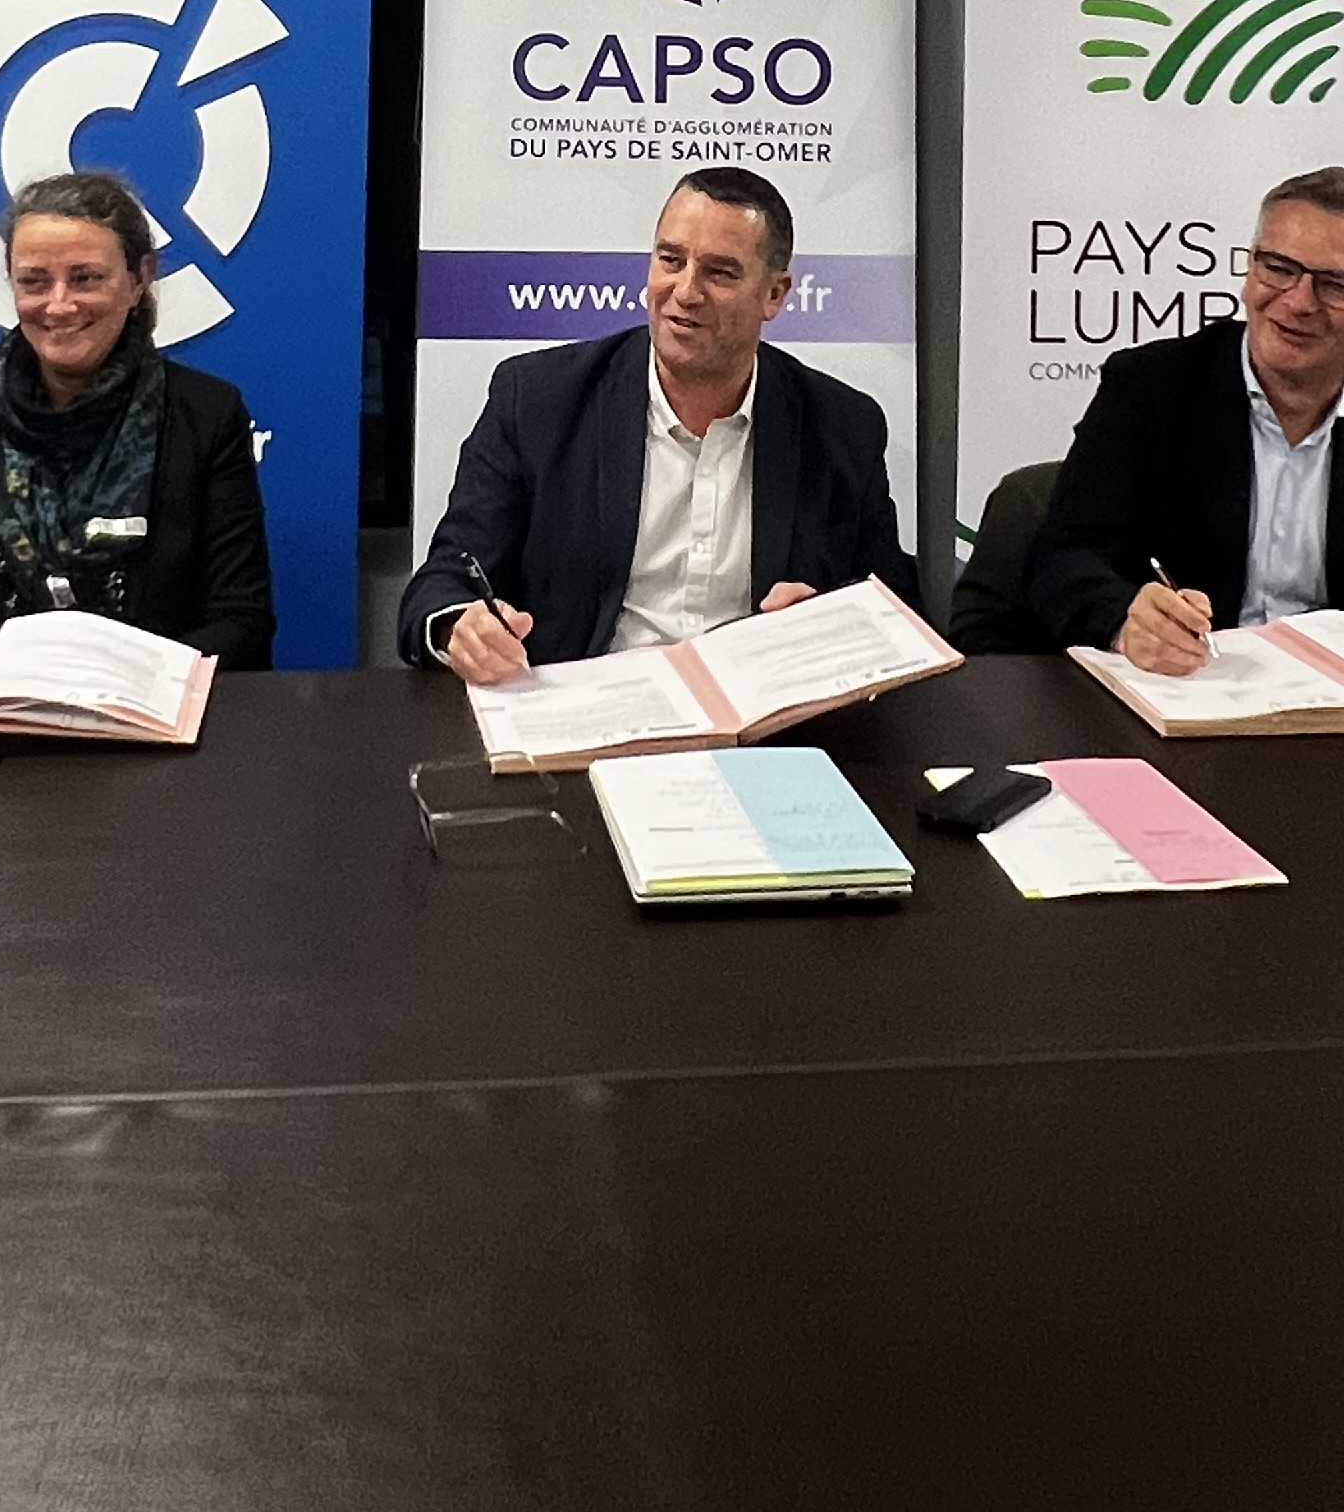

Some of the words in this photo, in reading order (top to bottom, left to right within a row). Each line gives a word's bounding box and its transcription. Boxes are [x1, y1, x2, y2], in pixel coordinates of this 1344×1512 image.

[513, 32, 832, 105] CAPSO
[510, 117, 646, 134] COMMUNAUTÉ
[654, 119, 833, 136] D'AGGLOMÉRATION
[510, 139, 546, 158] DU
[556, 139, 617, 160] PAYS
[628, 141, 662, 160] DE
[671, 141, 832, 163] SAINT-OMER
[1031, 220, 1217, 276] PAYS
